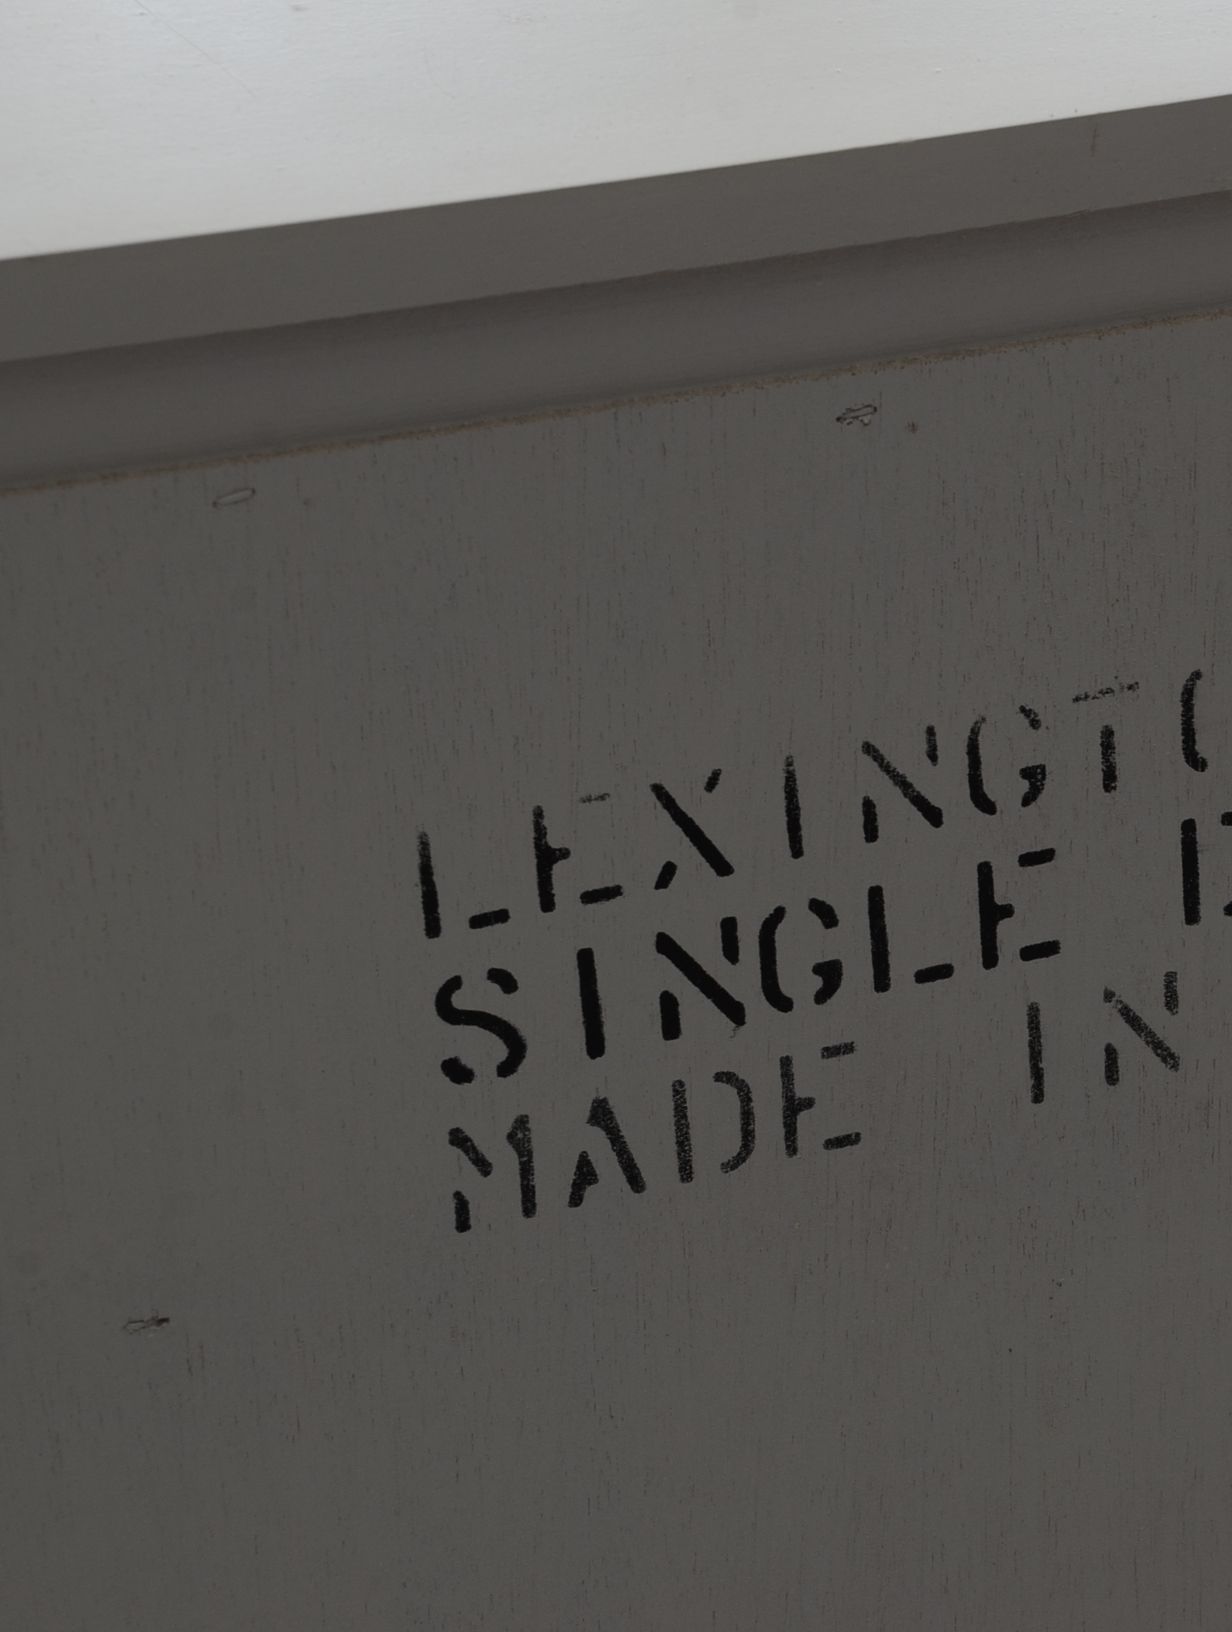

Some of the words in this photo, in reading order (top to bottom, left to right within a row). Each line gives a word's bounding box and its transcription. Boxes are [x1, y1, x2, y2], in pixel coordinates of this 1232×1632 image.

[434, 847, 1063, 1087] SINGLE
[446, 1040, 863, 1235] MADE
[1026, 970, 1181, 1105] IN
